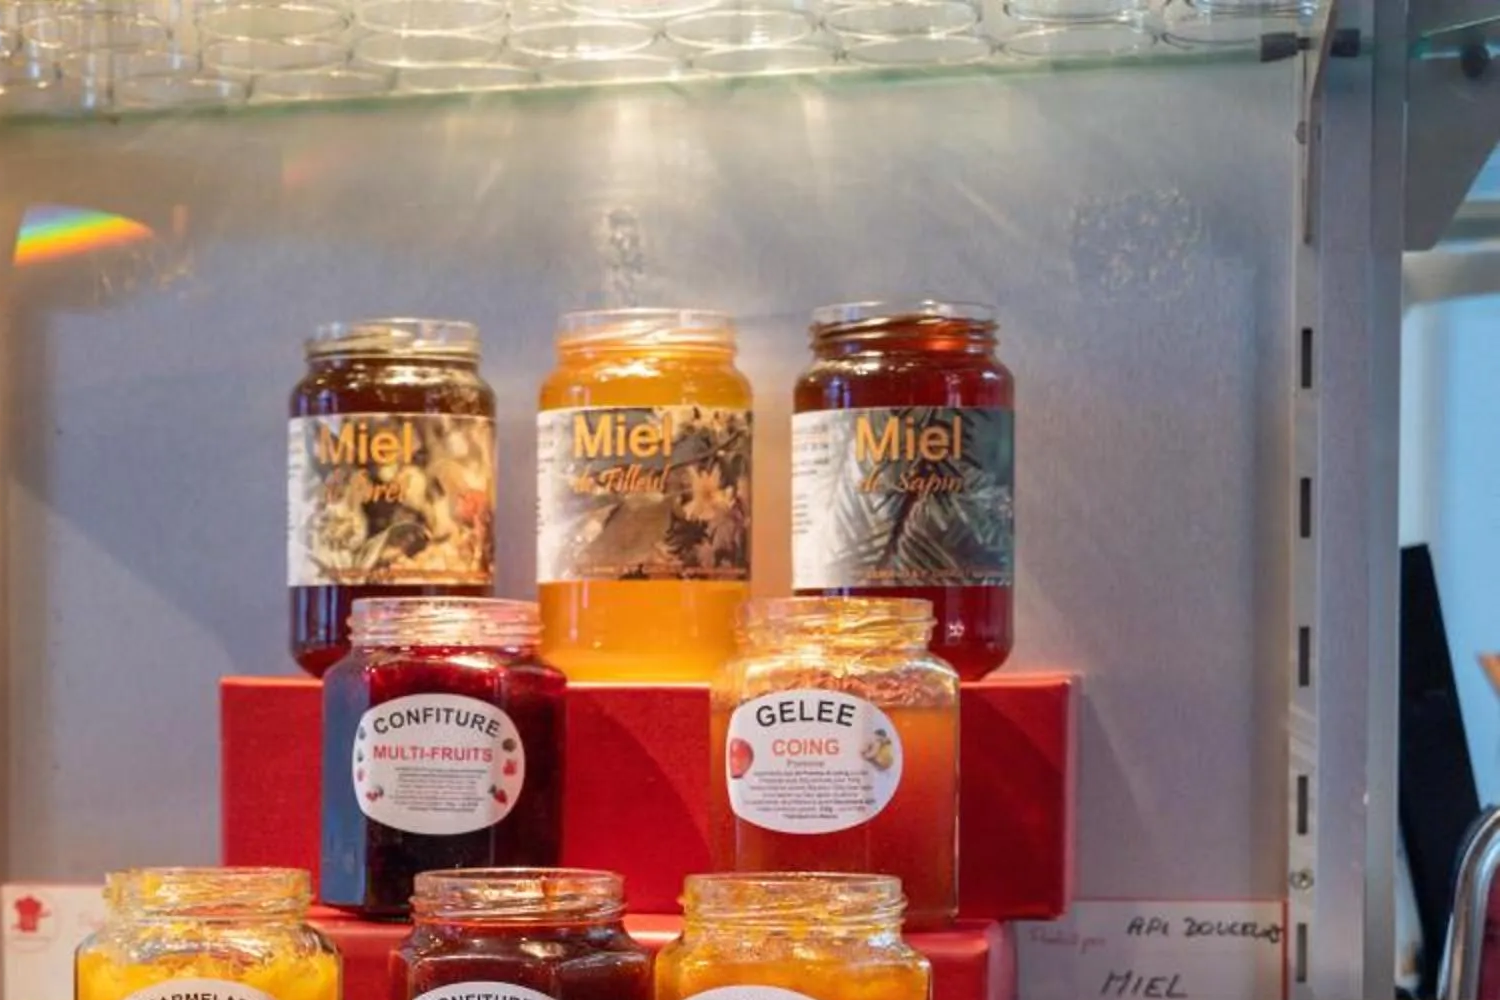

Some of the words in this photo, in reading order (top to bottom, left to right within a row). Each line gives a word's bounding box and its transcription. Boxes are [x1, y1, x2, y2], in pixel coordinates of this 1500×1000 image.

[319, 421, 414, 465] Miel
[573, 413, 674, 458] Miel
[855, 415, 962, 462] Miel
[372, 706, 501, 738] CONFITURE
[755, 699, 857, 728] GELEE
[372, 744, 494, 763] MULTI-FRUITS
[771, 738, 841, 757] COING
[1100, 969, 1189, 999] MIEL
